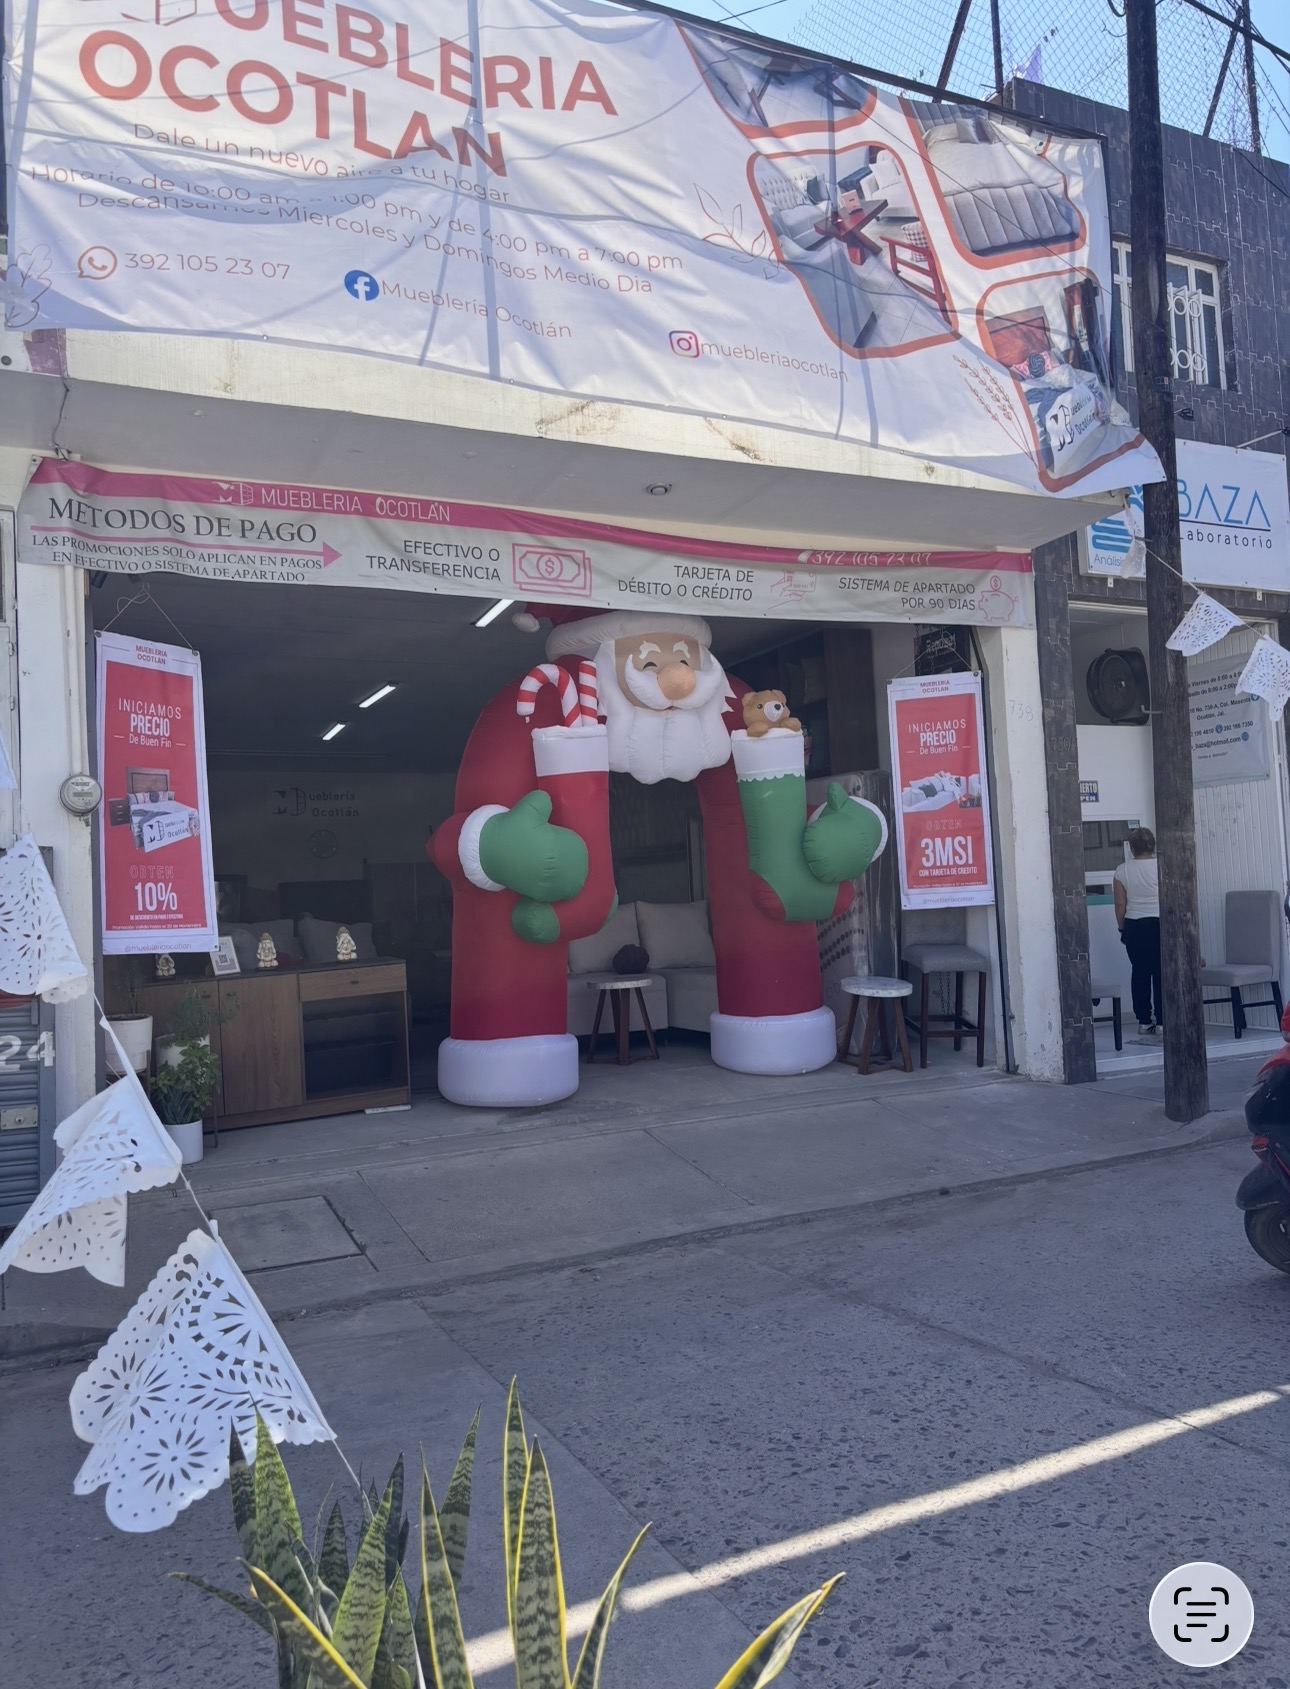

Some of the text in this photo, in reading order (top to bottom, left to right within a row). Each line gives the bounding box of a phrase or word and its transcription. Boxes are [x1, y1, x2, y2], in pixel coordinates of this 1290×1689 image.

[78, 31, 508, 178] OCOTLAN
[133, 123, 197, 149] Dale
[205, 136, 239, 156] un
[249, 143, 329, 177] nuevo
[391, 165, 403, 175] a
[411, 165, 436, 180] tu
[444, 173, 510, 203] hogar
[31, 164, 132, 185] Horario
[141, 174, 175, 192] de
[186, 182, 251, 200] 10:00
[259, 192, 300, 205] am
[384, 201, 422, 222] pm
[428, 213, 442, 229] y
[448, 218, 476, 236] de
[483, 227, 527, 253] 4:00
[535, 240, 571, 260] pm
[577, 247, 590, 261] a
[595, 246, 641, 268] 7:00
[647, 252, 684, 272] pm
[278, 206, 398, 242] Miercoles
[403, 234, 416, 249] y
[424, 233, 537, 281] Domingos
[543, 264, 610, 290] Medio
[617, 275, 652, 293] Dia
[125, 253, 291, 280] 392 105 23 07
[381, 280, 572, 339] Mueblería Ocotlán
[700, 341, 849, 383] muebleriaocotlan
[261, 487, 363, 513] MUEBLERIA
[49, 497, 317, 543] METODOS DE PAGO
[1180, 528, 1273, 549] aboratorio
[32, 535, 322, 570] LAS PROMOCIONES SOLO APLICAN EN PAGOS
[403, 539, 500, 562] EFECTIVO O
[852, 552, 880, 566] 105
[886, 552, 906, 566] 23
[910, 552, 932, 566] 07
[53, 551, 306, 583] EN EFECTIVO O SISTEMA DE APARTADO
[365, 555, 501, 581] TRANSFERENCIA
[674, 565, 754, 583] TARJETA DE
[618, 577, 753, 601] DÉBITO O CRÉDITO
[838, 577, 976, 595] SISTEMA DE APARTADO
[901, 597, 976, 611] POR 90 DIAS
[136, 645, 168, 658] MUEBLERIA
[137, 653, 166, 665] OCOTLAN
[922, 686, 949, 694] OCOTLAN
[118, 697, 182, 720] INICIAMOS
[1008, 699, 1034, 721] 738
[130, 713, 171, 737] PRECIO
[908, 718, 967, 734] INICIAMOS
[129, 733, 172, 748] De Buen Fin
[920, 729, 957, 747] PRECIO
[920, 744, 958, 755] De Buen Fin
[312, 806, 360, 817] Ocotlán
[920, 835, 973, 867] 3MSI
[130, 865, 174, 879] OBTEN
[919, 869, 929, 877] CON
[134, 882, 178, 911] 10%
